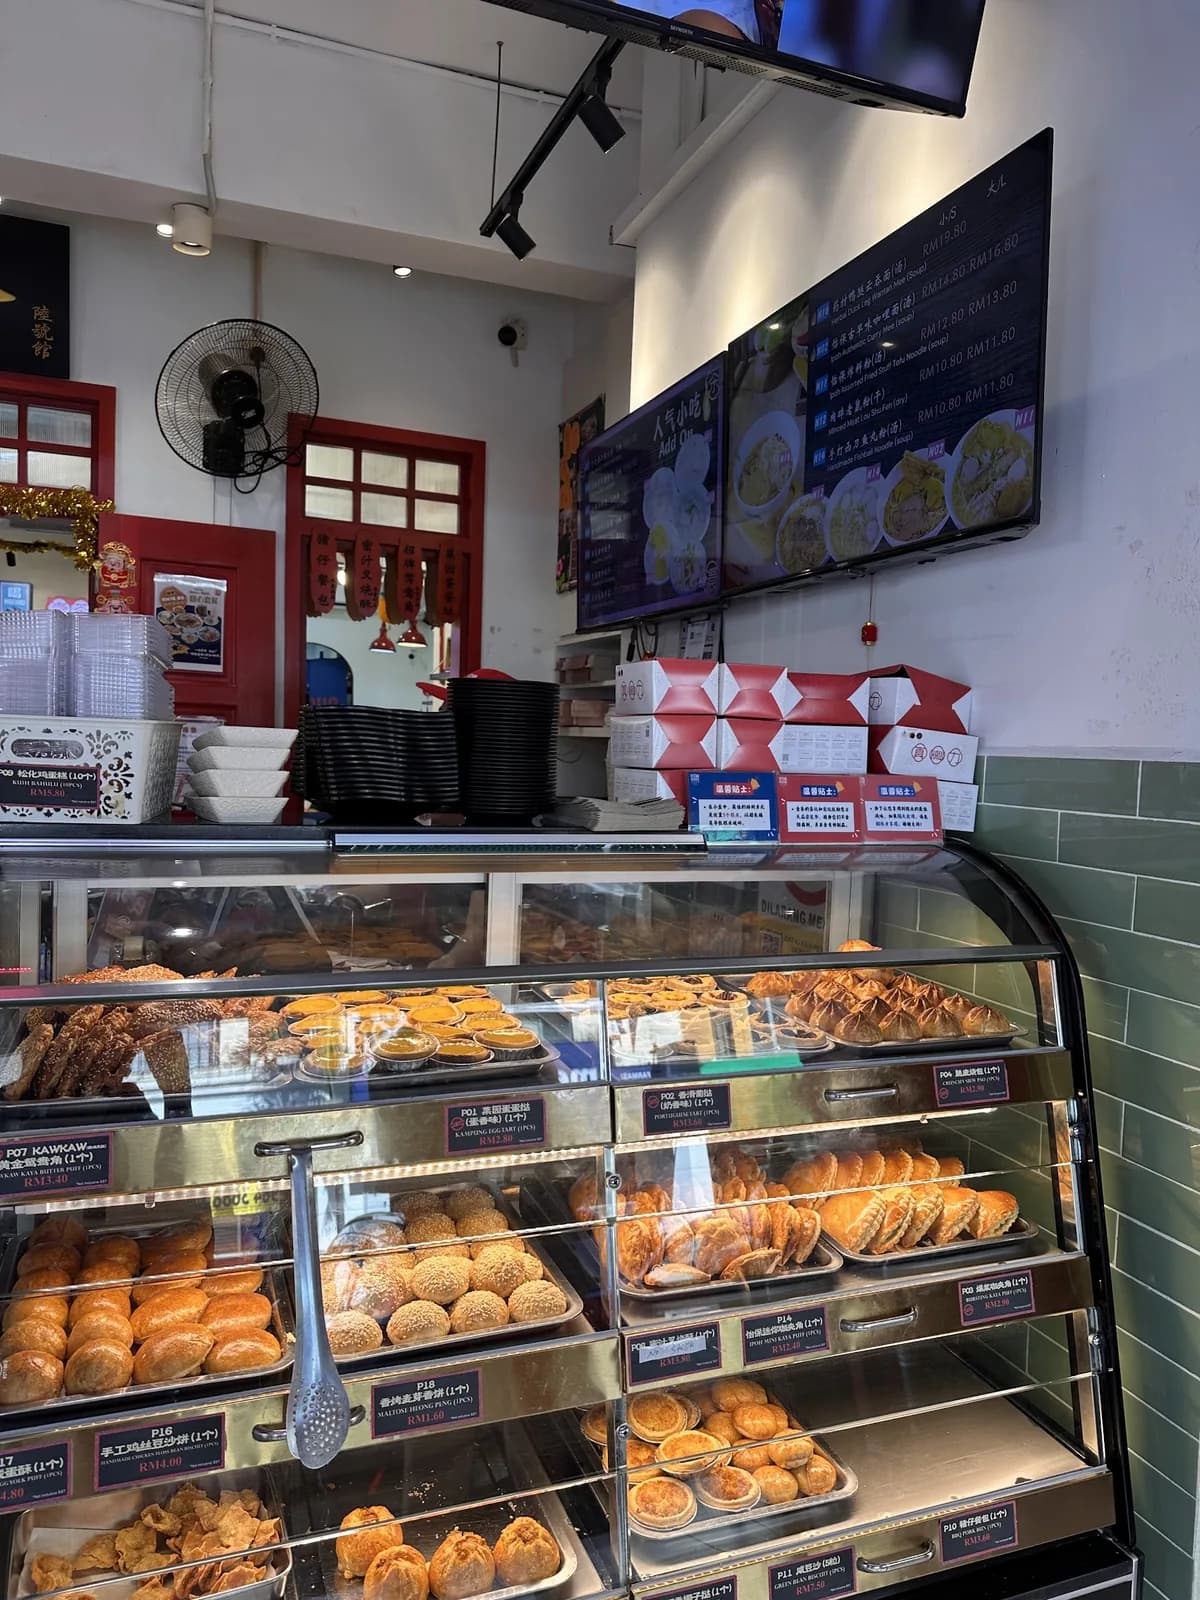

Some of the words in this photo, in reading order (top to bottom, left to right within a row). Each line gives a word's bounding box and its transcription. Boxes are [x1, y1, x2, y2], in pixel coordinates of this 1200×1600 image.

[653, 391, 702, 441] 人气小吃
[658, 435, 677, 459] Add
[18, 769, 97, 781] 松化鸡蛋糕(10个)
[30, 788, 65, 798] RM5.80
[660, 1092, 676, 1101] P02
[660, 1100, 693, 1111] (奶香味)
[694, 1097, 714, 1107] (1个)
[461, 1107, 477, 1117] P01
[465, 1114, 503, 1127] (蛋香味)
[504, 1112, 527, 1123] (1个)
[6, 1147, 28, 1159] P07
[32, 1141, 88, 1156] KAWKAW
[24, 1174, 68, 1188] RM3.40
[777, 1314, 793, 1324] P14
[416, 1379, 436, 1391] P18
[407, 1412, 445, 1426] RM1.60
[151, 1426, 173, 1438] P16
[100, 1428, 219, 1458] 手工鸡丝豆沙饼(1个)
[139, 1456, 183, 1473] RM4.00
[943, 1522, 958, 1533] P10
[777, 1569, 793, 1581] P11
[796, 1580, 826, 1596] RM7.50
